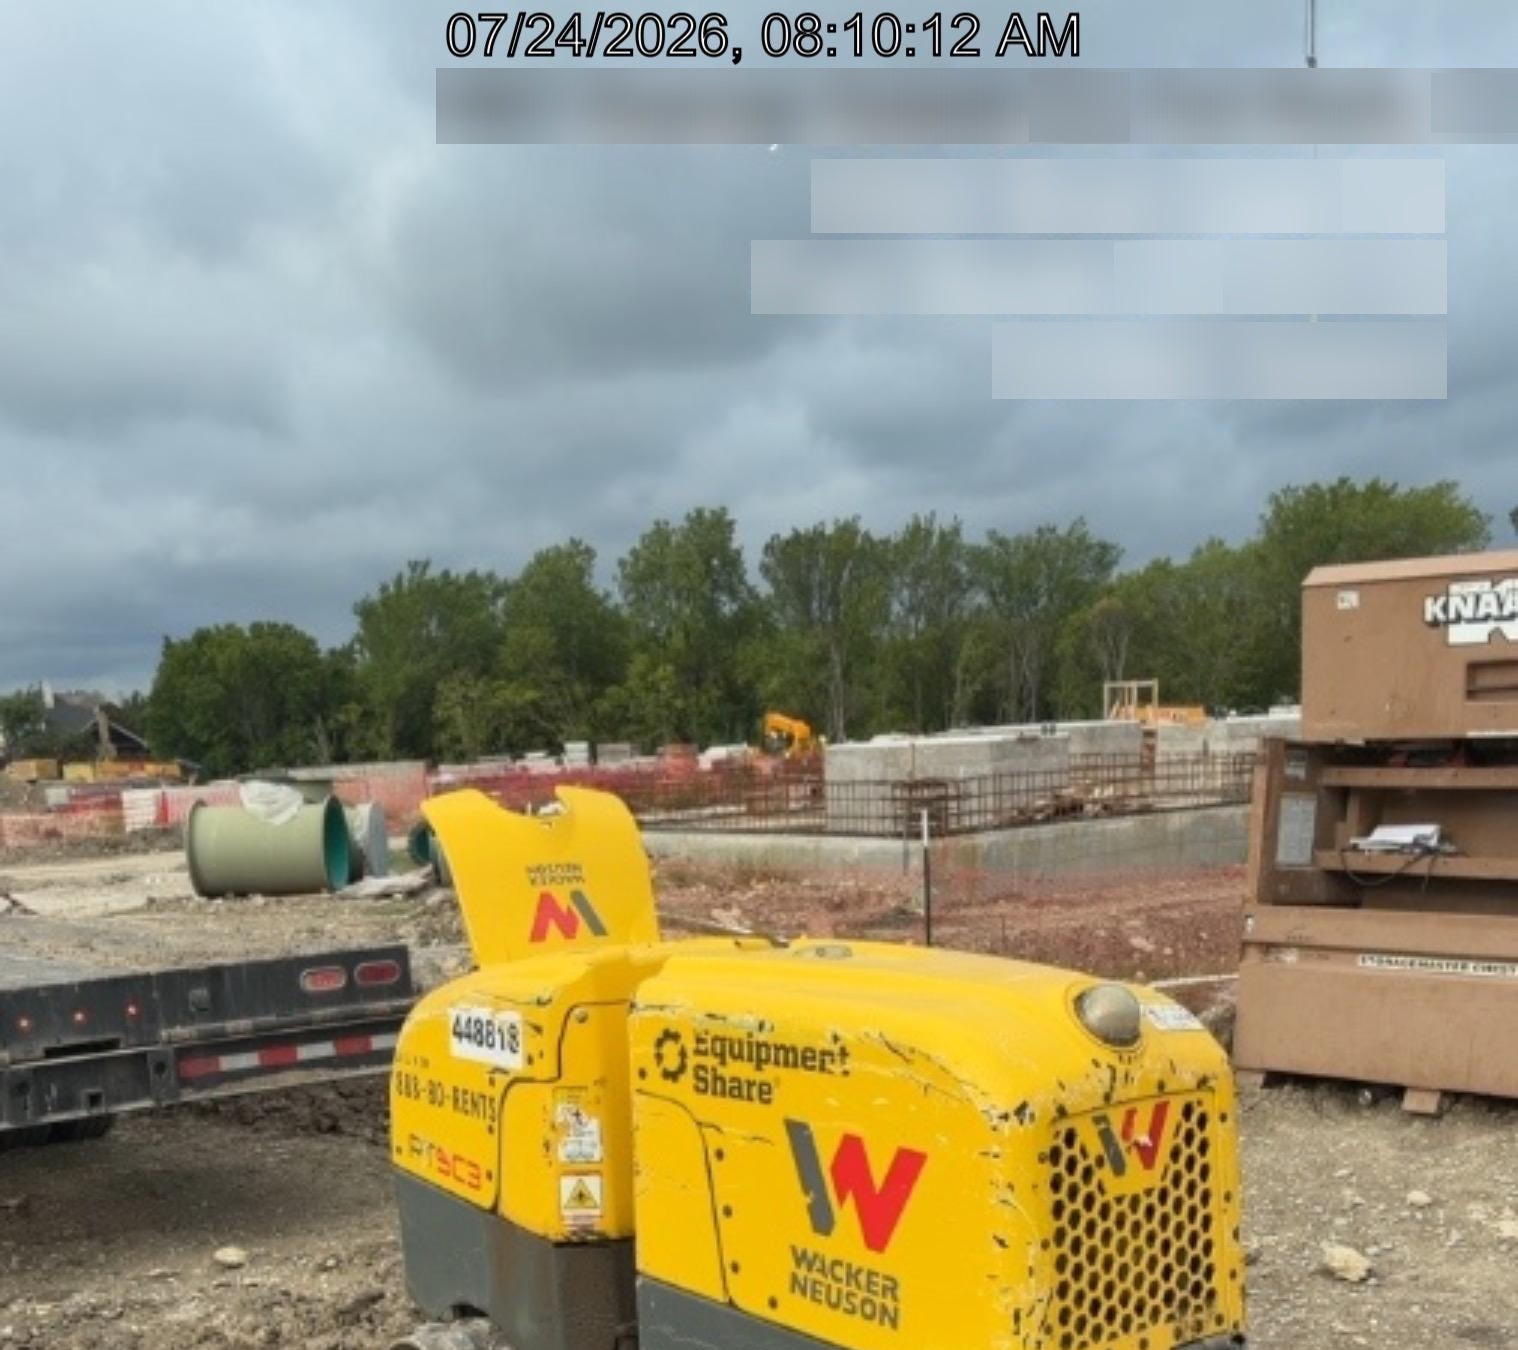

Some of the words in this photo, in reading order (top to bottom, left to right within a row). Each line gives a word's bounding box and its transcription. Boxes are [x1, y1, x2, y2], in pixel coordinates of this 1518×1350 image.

[694, 1028, 850, 1077] Equipment
[693, 1064, 773, 1104] Share
[789, 1244, 899, 1302] WACKER
[789, 1271, 899, 1331] NEUSON
